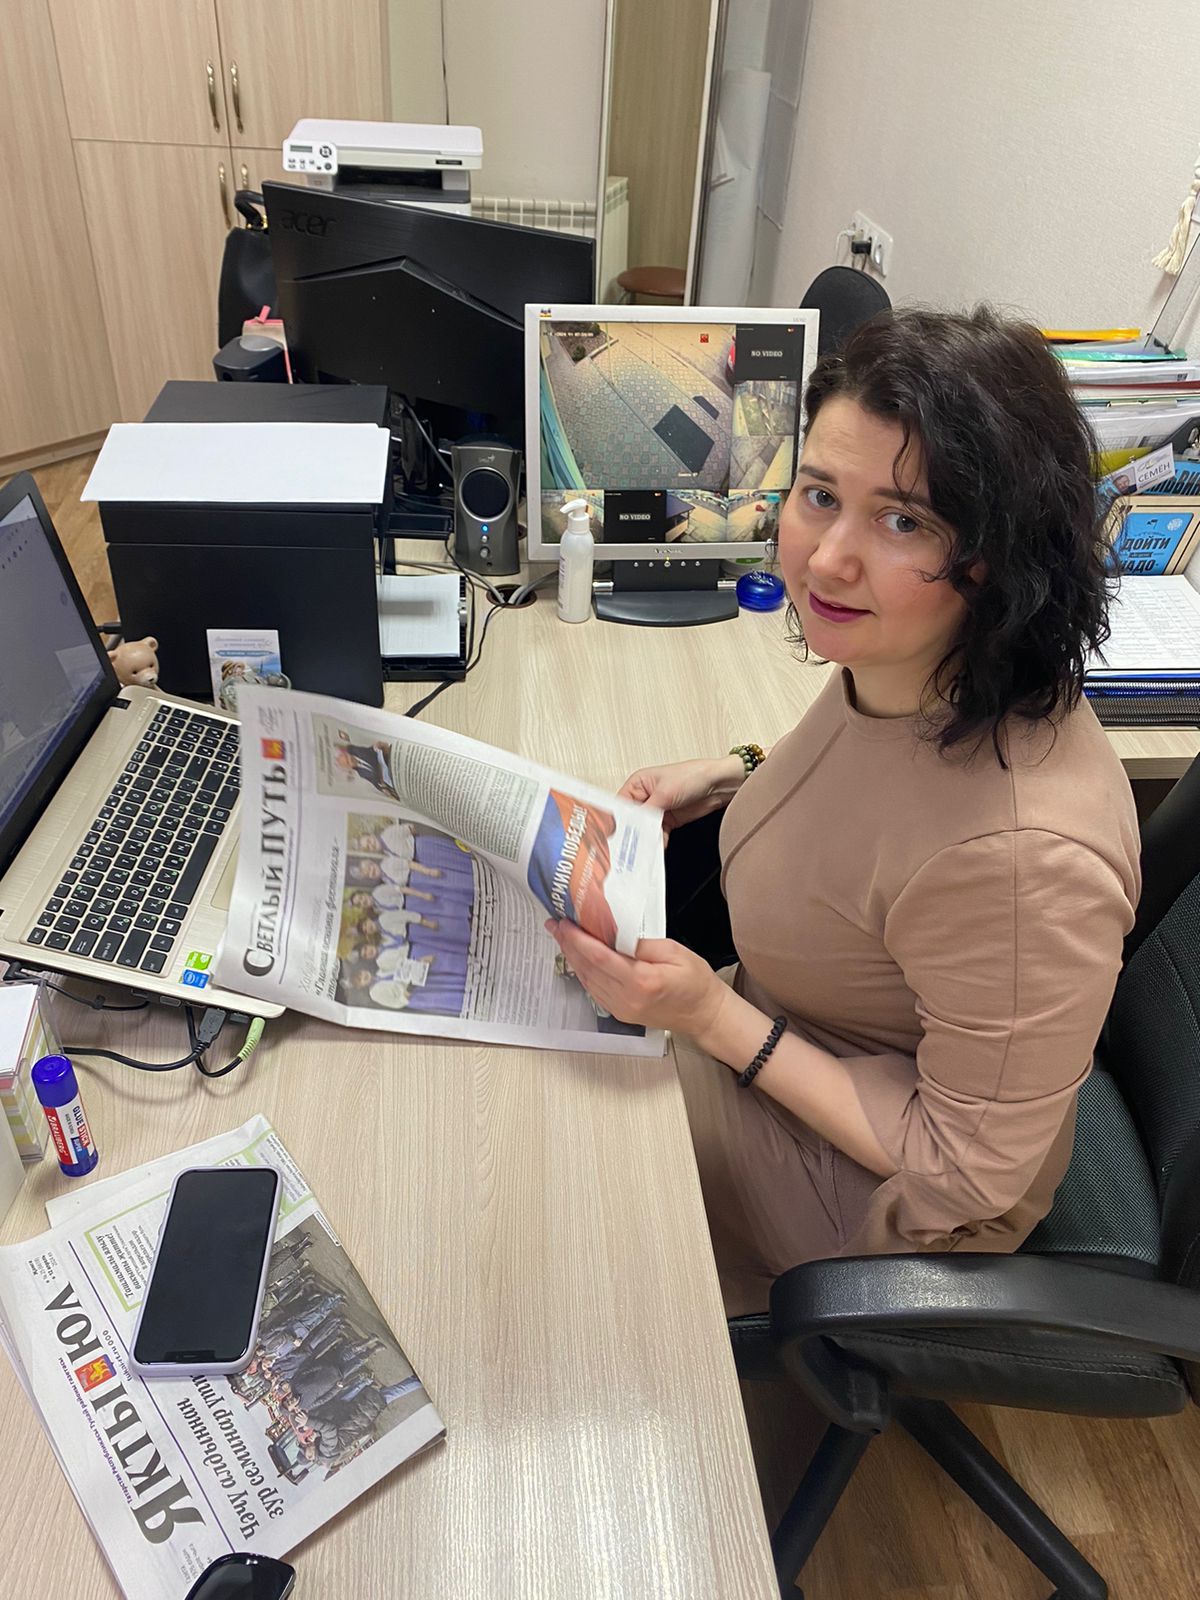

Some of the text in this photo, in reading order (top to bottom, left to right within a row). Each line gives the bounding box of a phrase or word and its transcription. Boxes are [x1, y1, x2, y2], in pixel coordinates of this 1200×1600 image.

[280, 209, 337, 238] acer
[762, 350, 783, 358] VIDEO
[1121, 535, 1171, 551] ДОЙТИ
[261, 765, 286, 854] ПУТЬ
[552, 859, 574, 909] АРМИЮ
[72, 1105, 91, 1145] GLUE STICK
[45, 1281, 104, 1364] ЮЛ
[80, 1406, 98, 1430] Тукай
[90, 1426, 120, 1475] Республикасы
[90, 1380, 207, 1545] ЯКТЫ
[177, 1398, 259, 1539] Чәчү алдыннан
[189, 1374, 283, 1518] зур семинар үтт
[112, 1471, 134, 1505] Татарстан
